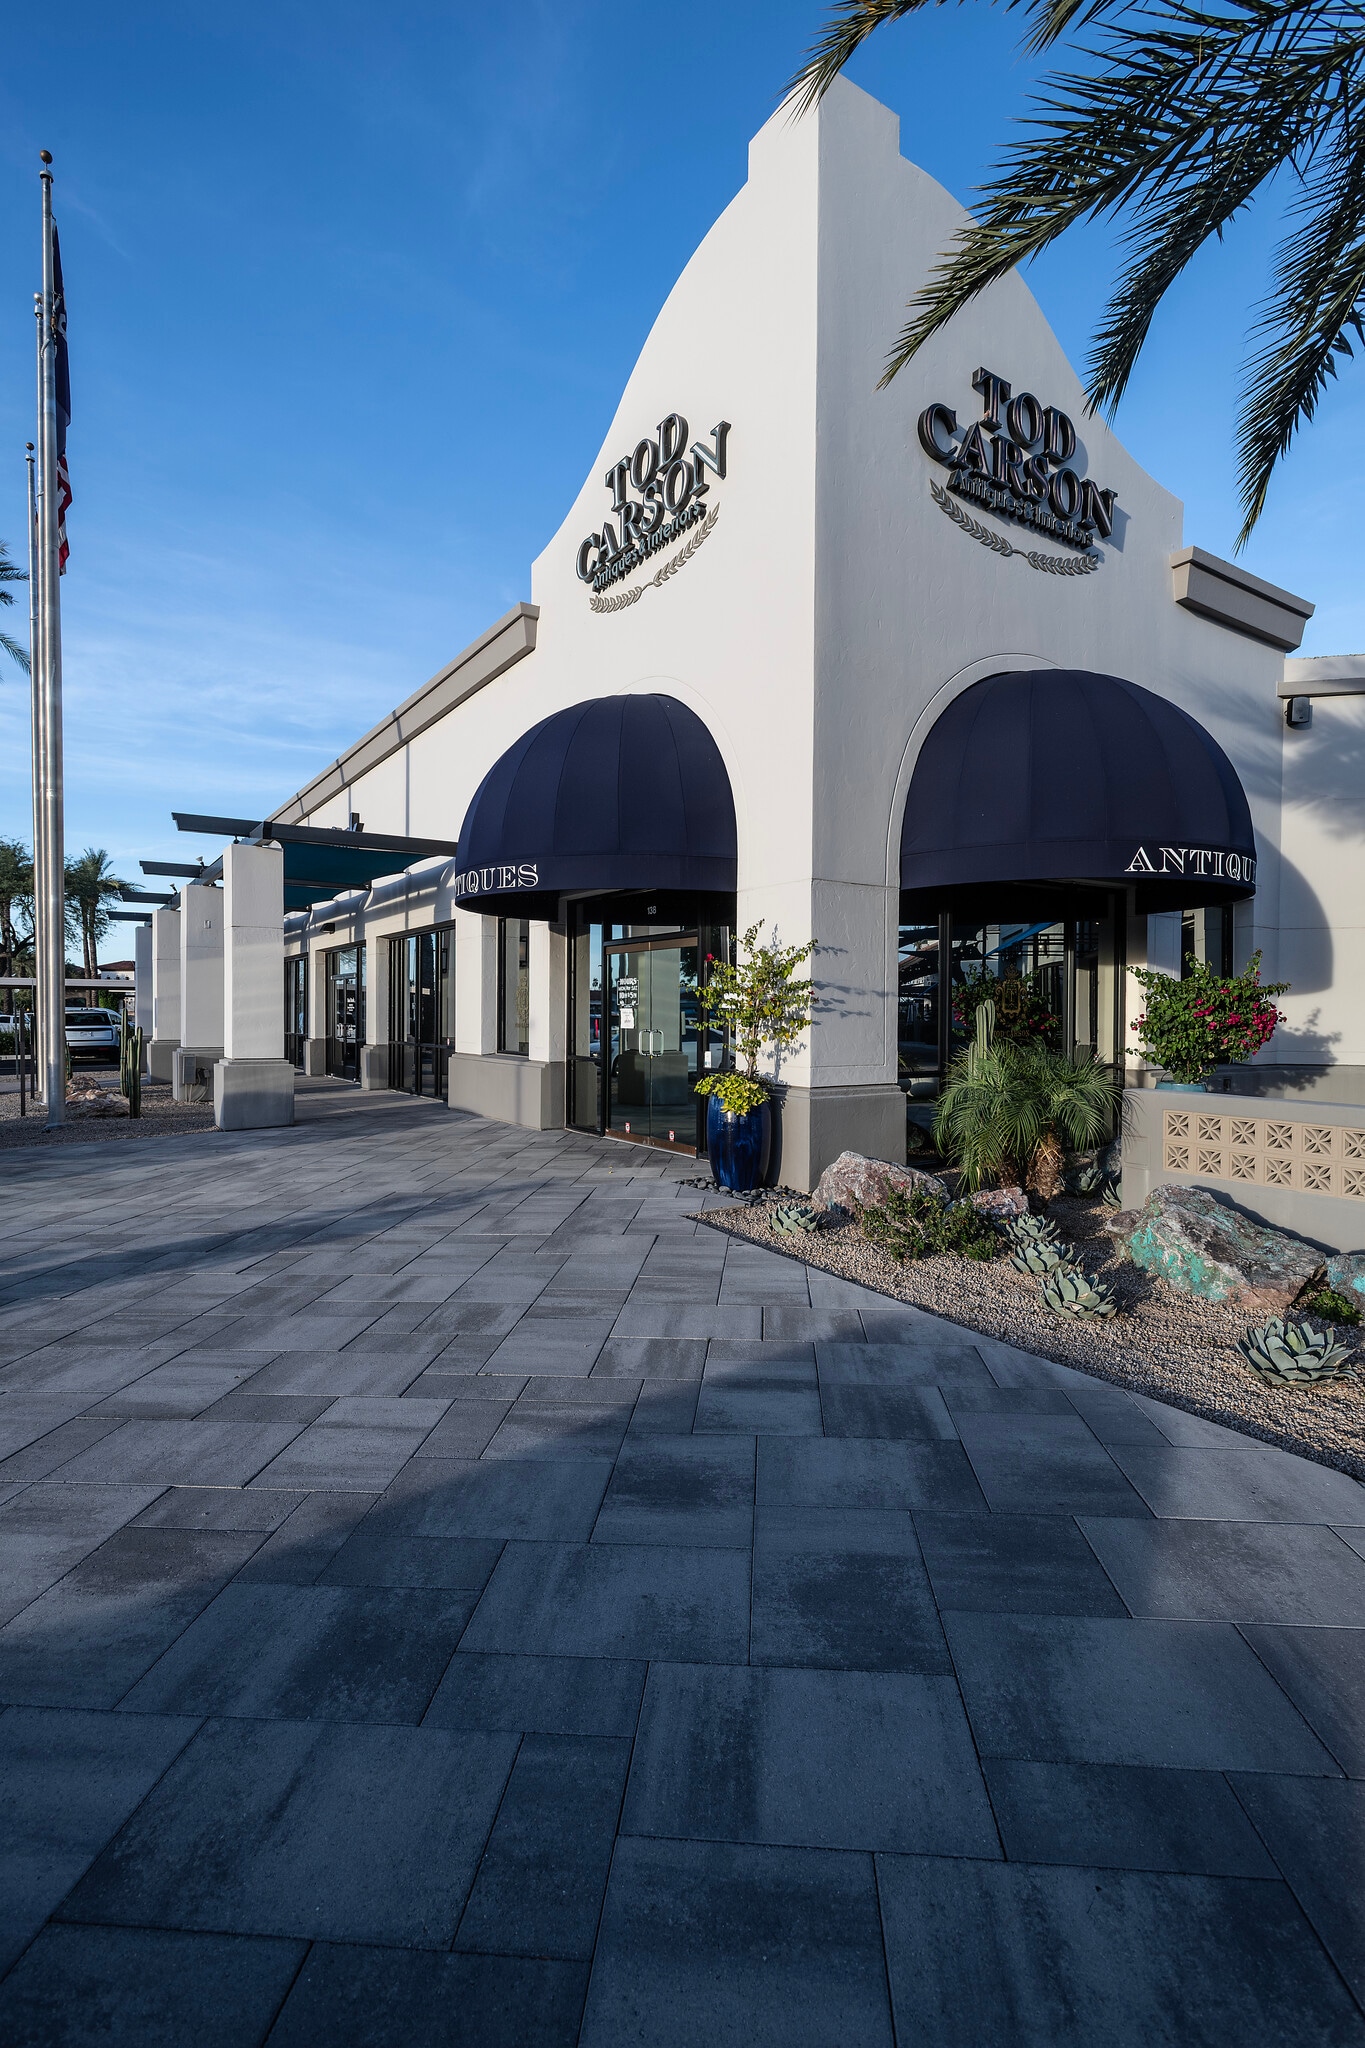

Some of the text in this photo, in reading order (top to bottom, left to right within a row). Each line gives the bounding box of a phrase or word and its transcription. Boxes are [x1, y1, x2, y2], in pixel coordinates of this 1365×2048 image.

[605, 413, 688, 512] TOD
[972, 366, 1076, 465] TOD
[576, 420, 732, 584] CARSON
[917, 402, 1118, 538] CARSON
[946, 469, 1024, 518] Antiques
[592, 548, 643, 595] Antiques
[648, 501, 707, 554] Interiors
[647, 905, 657, 915] 138
[1124, 846, 1256, 884] ANTIQU
